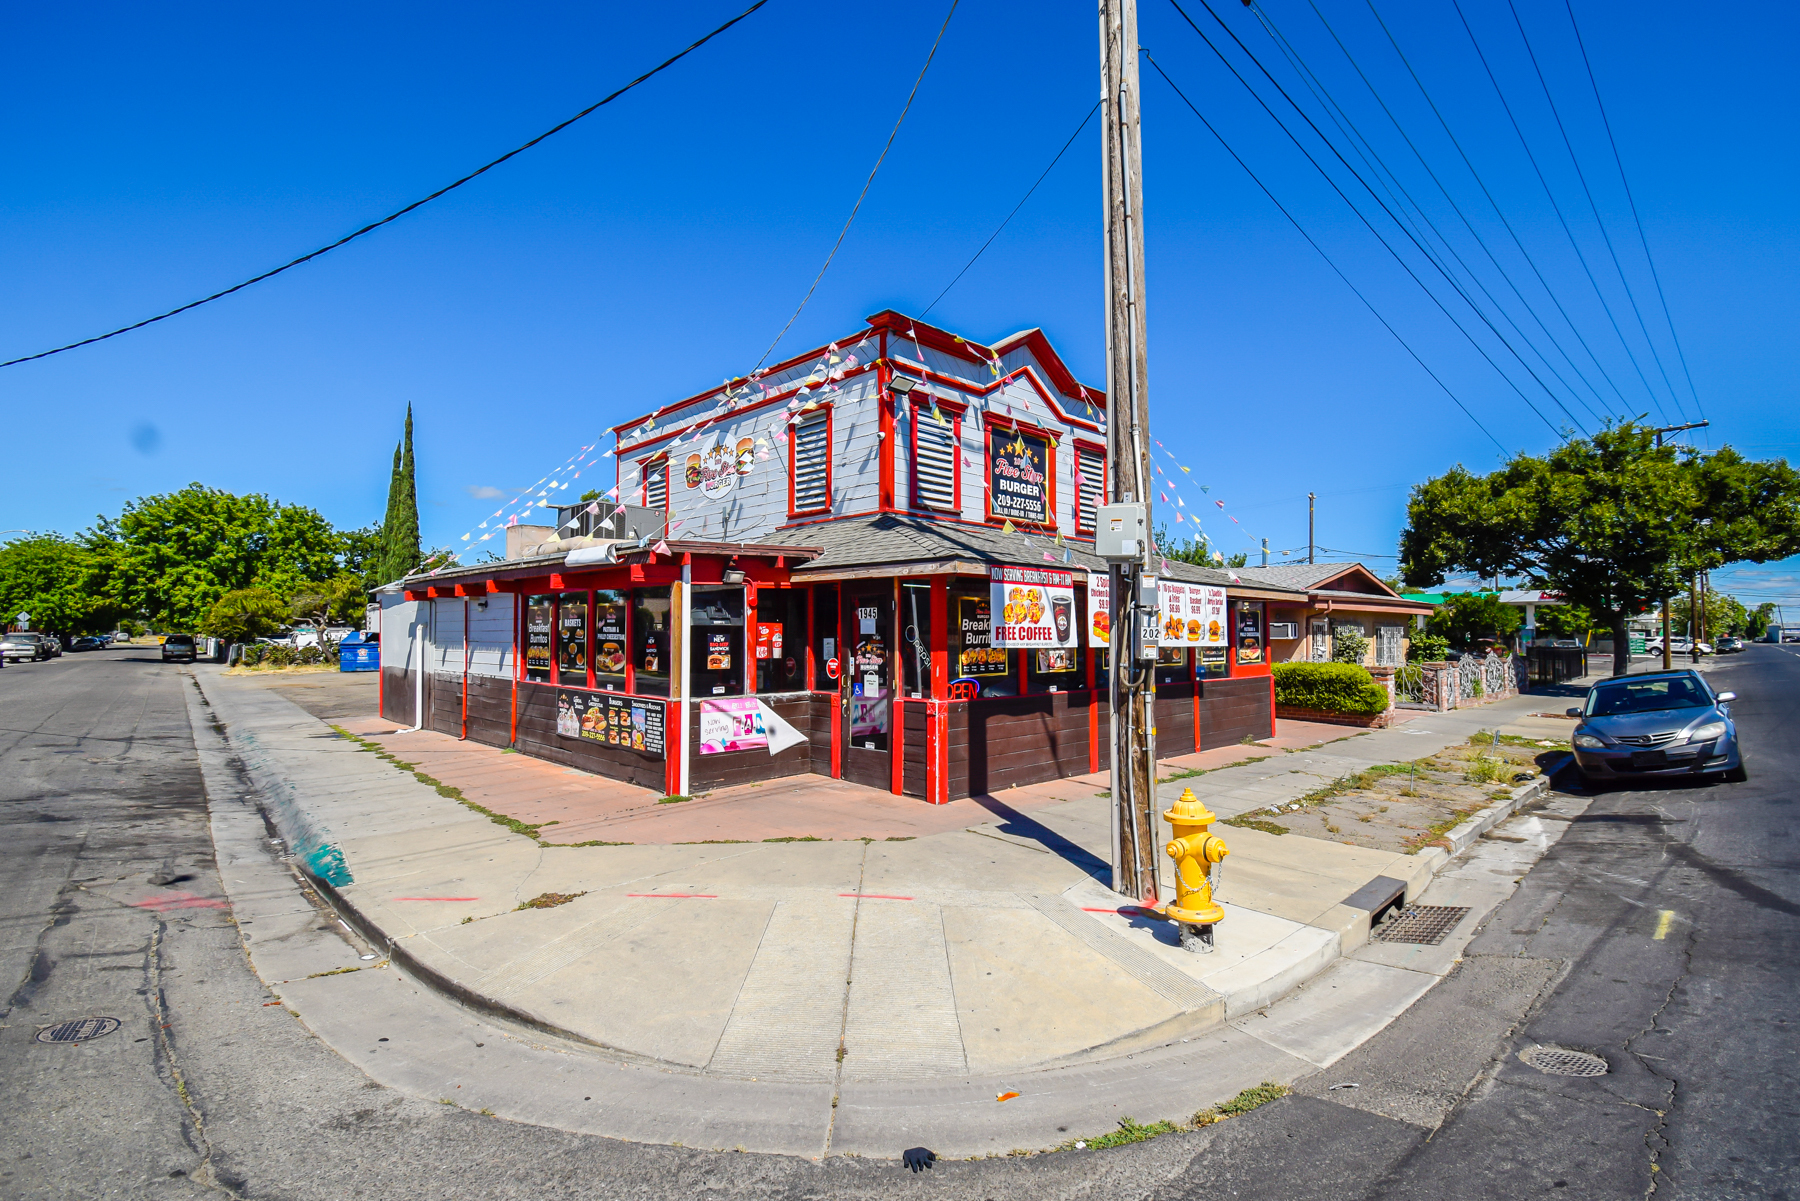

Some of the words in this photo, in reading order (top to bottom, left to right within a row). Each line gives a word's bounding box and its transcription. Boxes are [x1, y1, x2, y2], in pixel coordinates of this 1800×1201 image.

[994, 458, 1021, 478] Five
[1000, 479, 1040, 497] BURGER
[991, 566, 1004, 581] NOW
[1003, 568, 1024, 582] SERVING
[1024, 569, 1049, 585] BREAKFAST
[1099, 599, 1109, 610] $9.9
[1169, 603, 1180, 614] $6.99
[859, 608, 878, 619] 1945
[529, 623, 550, 633] Breakfast
[564, 618, 582, 627] BASKETS
[530, 633, 548, 643] Burritos
[995, 626, 1017, 641] FREE
[1018, 626, 1053, 641] COFFEE
[1142, 628, 1159, 640] 202
[947, 682, 978, 700] OPEN
